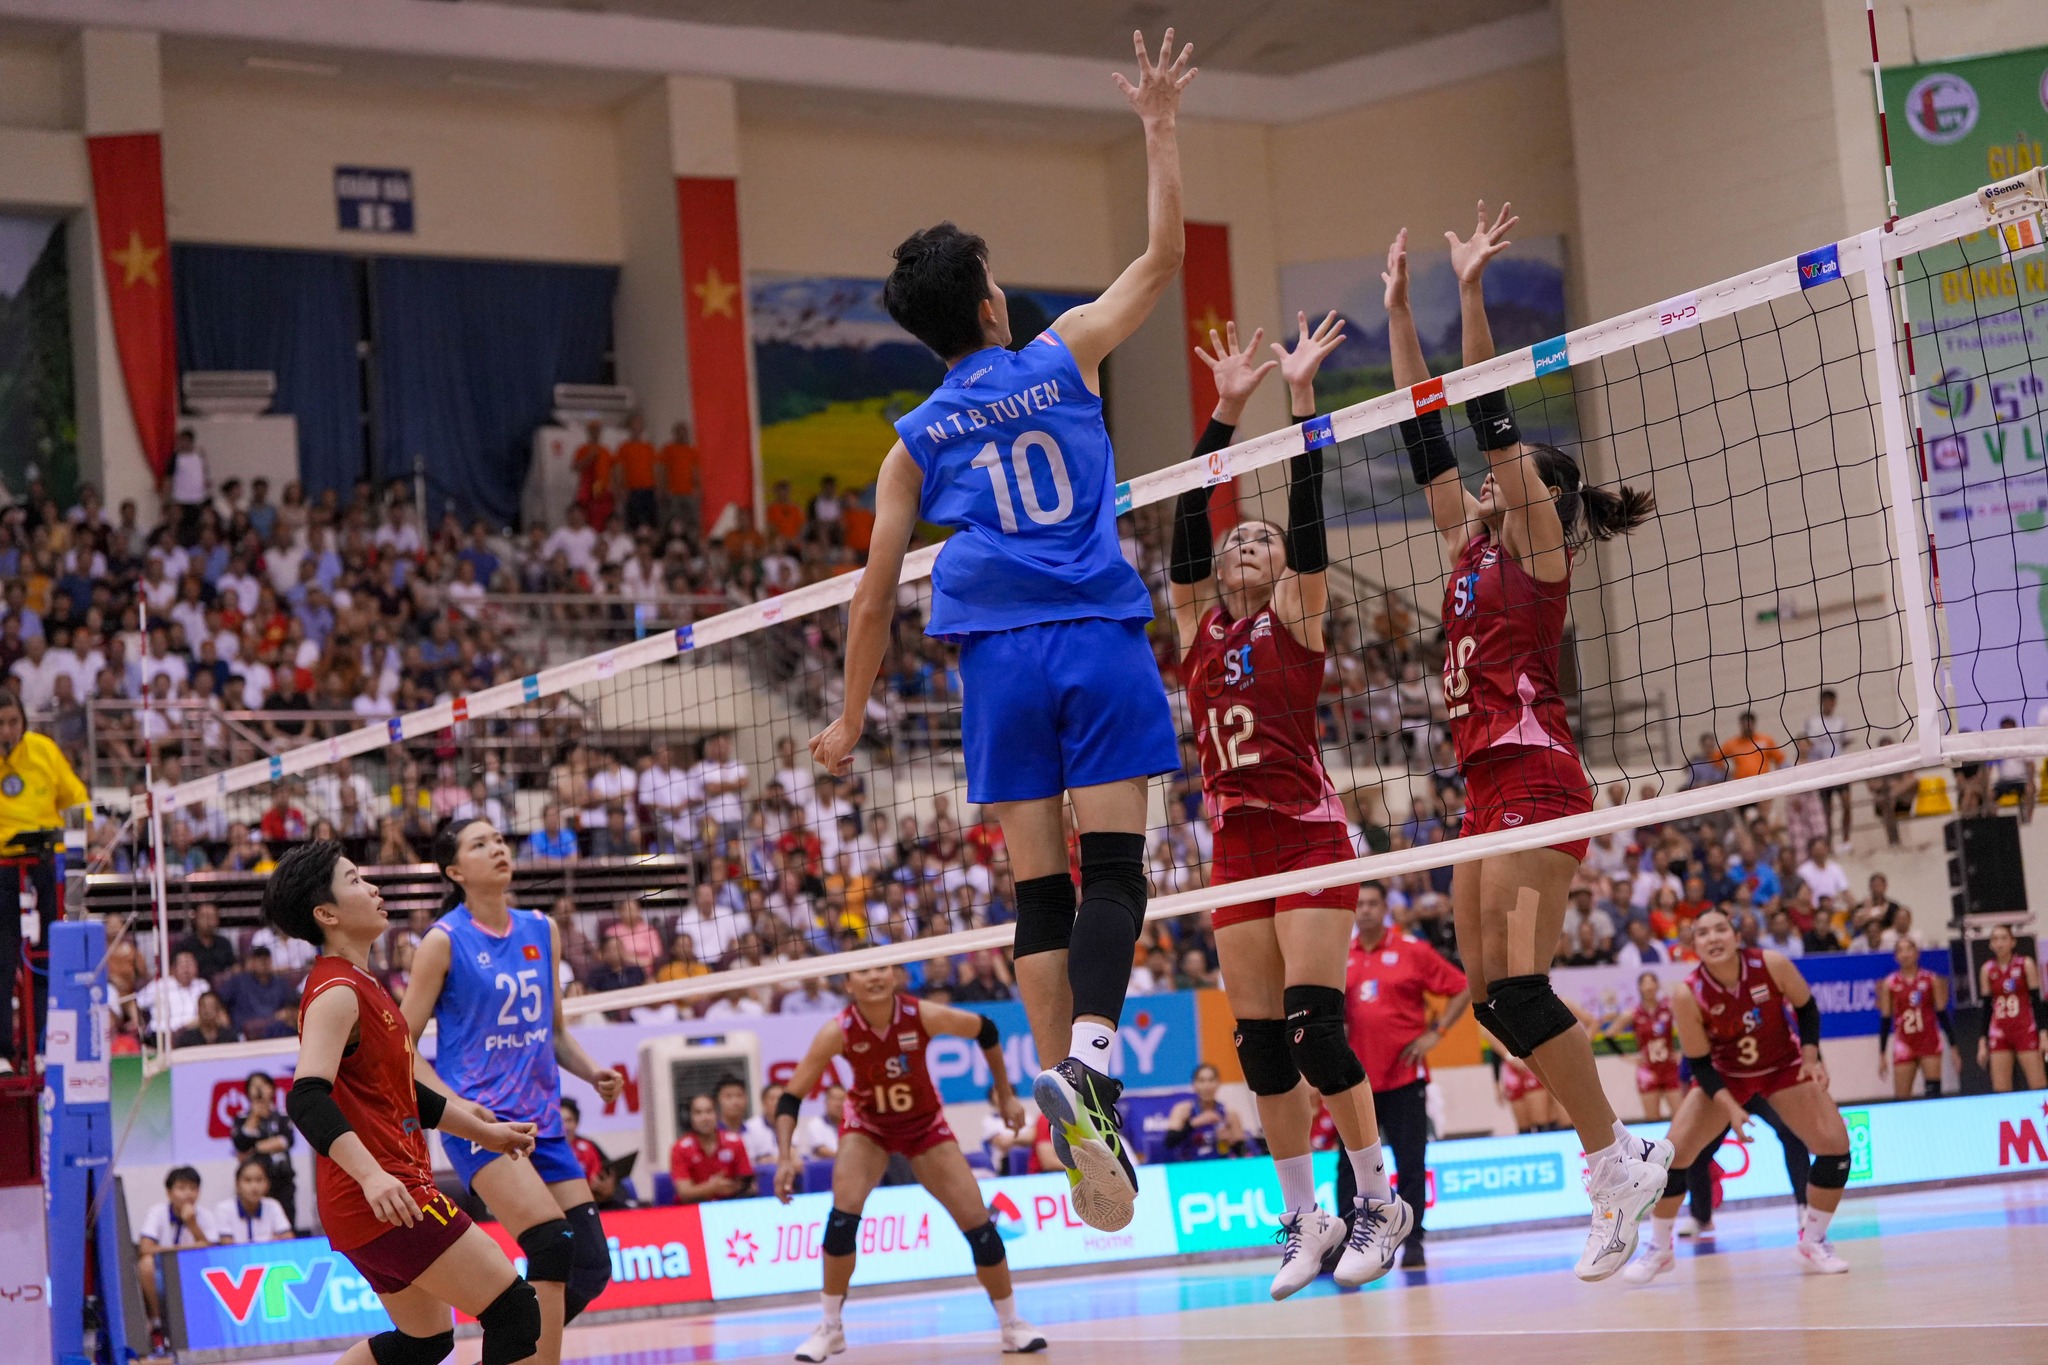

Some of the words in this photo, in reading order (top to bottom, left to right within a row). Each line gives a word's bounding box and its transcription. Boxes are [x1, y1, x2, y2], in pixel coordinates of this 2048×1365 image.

[1993, 181, 2025, 196] Senoh
[1661, 306, 1696, 326] BYD
[1535, 350, 1566, 368] PHUMY
[970, 430, 1074, 535] 10
[1207, 704, 1260, 771] 12
[495, 969, 542, 1026] 25
[1902, 1007, 1924, 1034] 21
[1737, 1036, 1760, 1066] 3
[874, 1082, 914, 1114] 16
[1442, 1160, 1557, 1194] SPORTS
[422, 1193, 459, 1226] 12
[771, 1213, 929, 1263] JOGBOLA
[1085, 1234, 1133, 1252] Home
